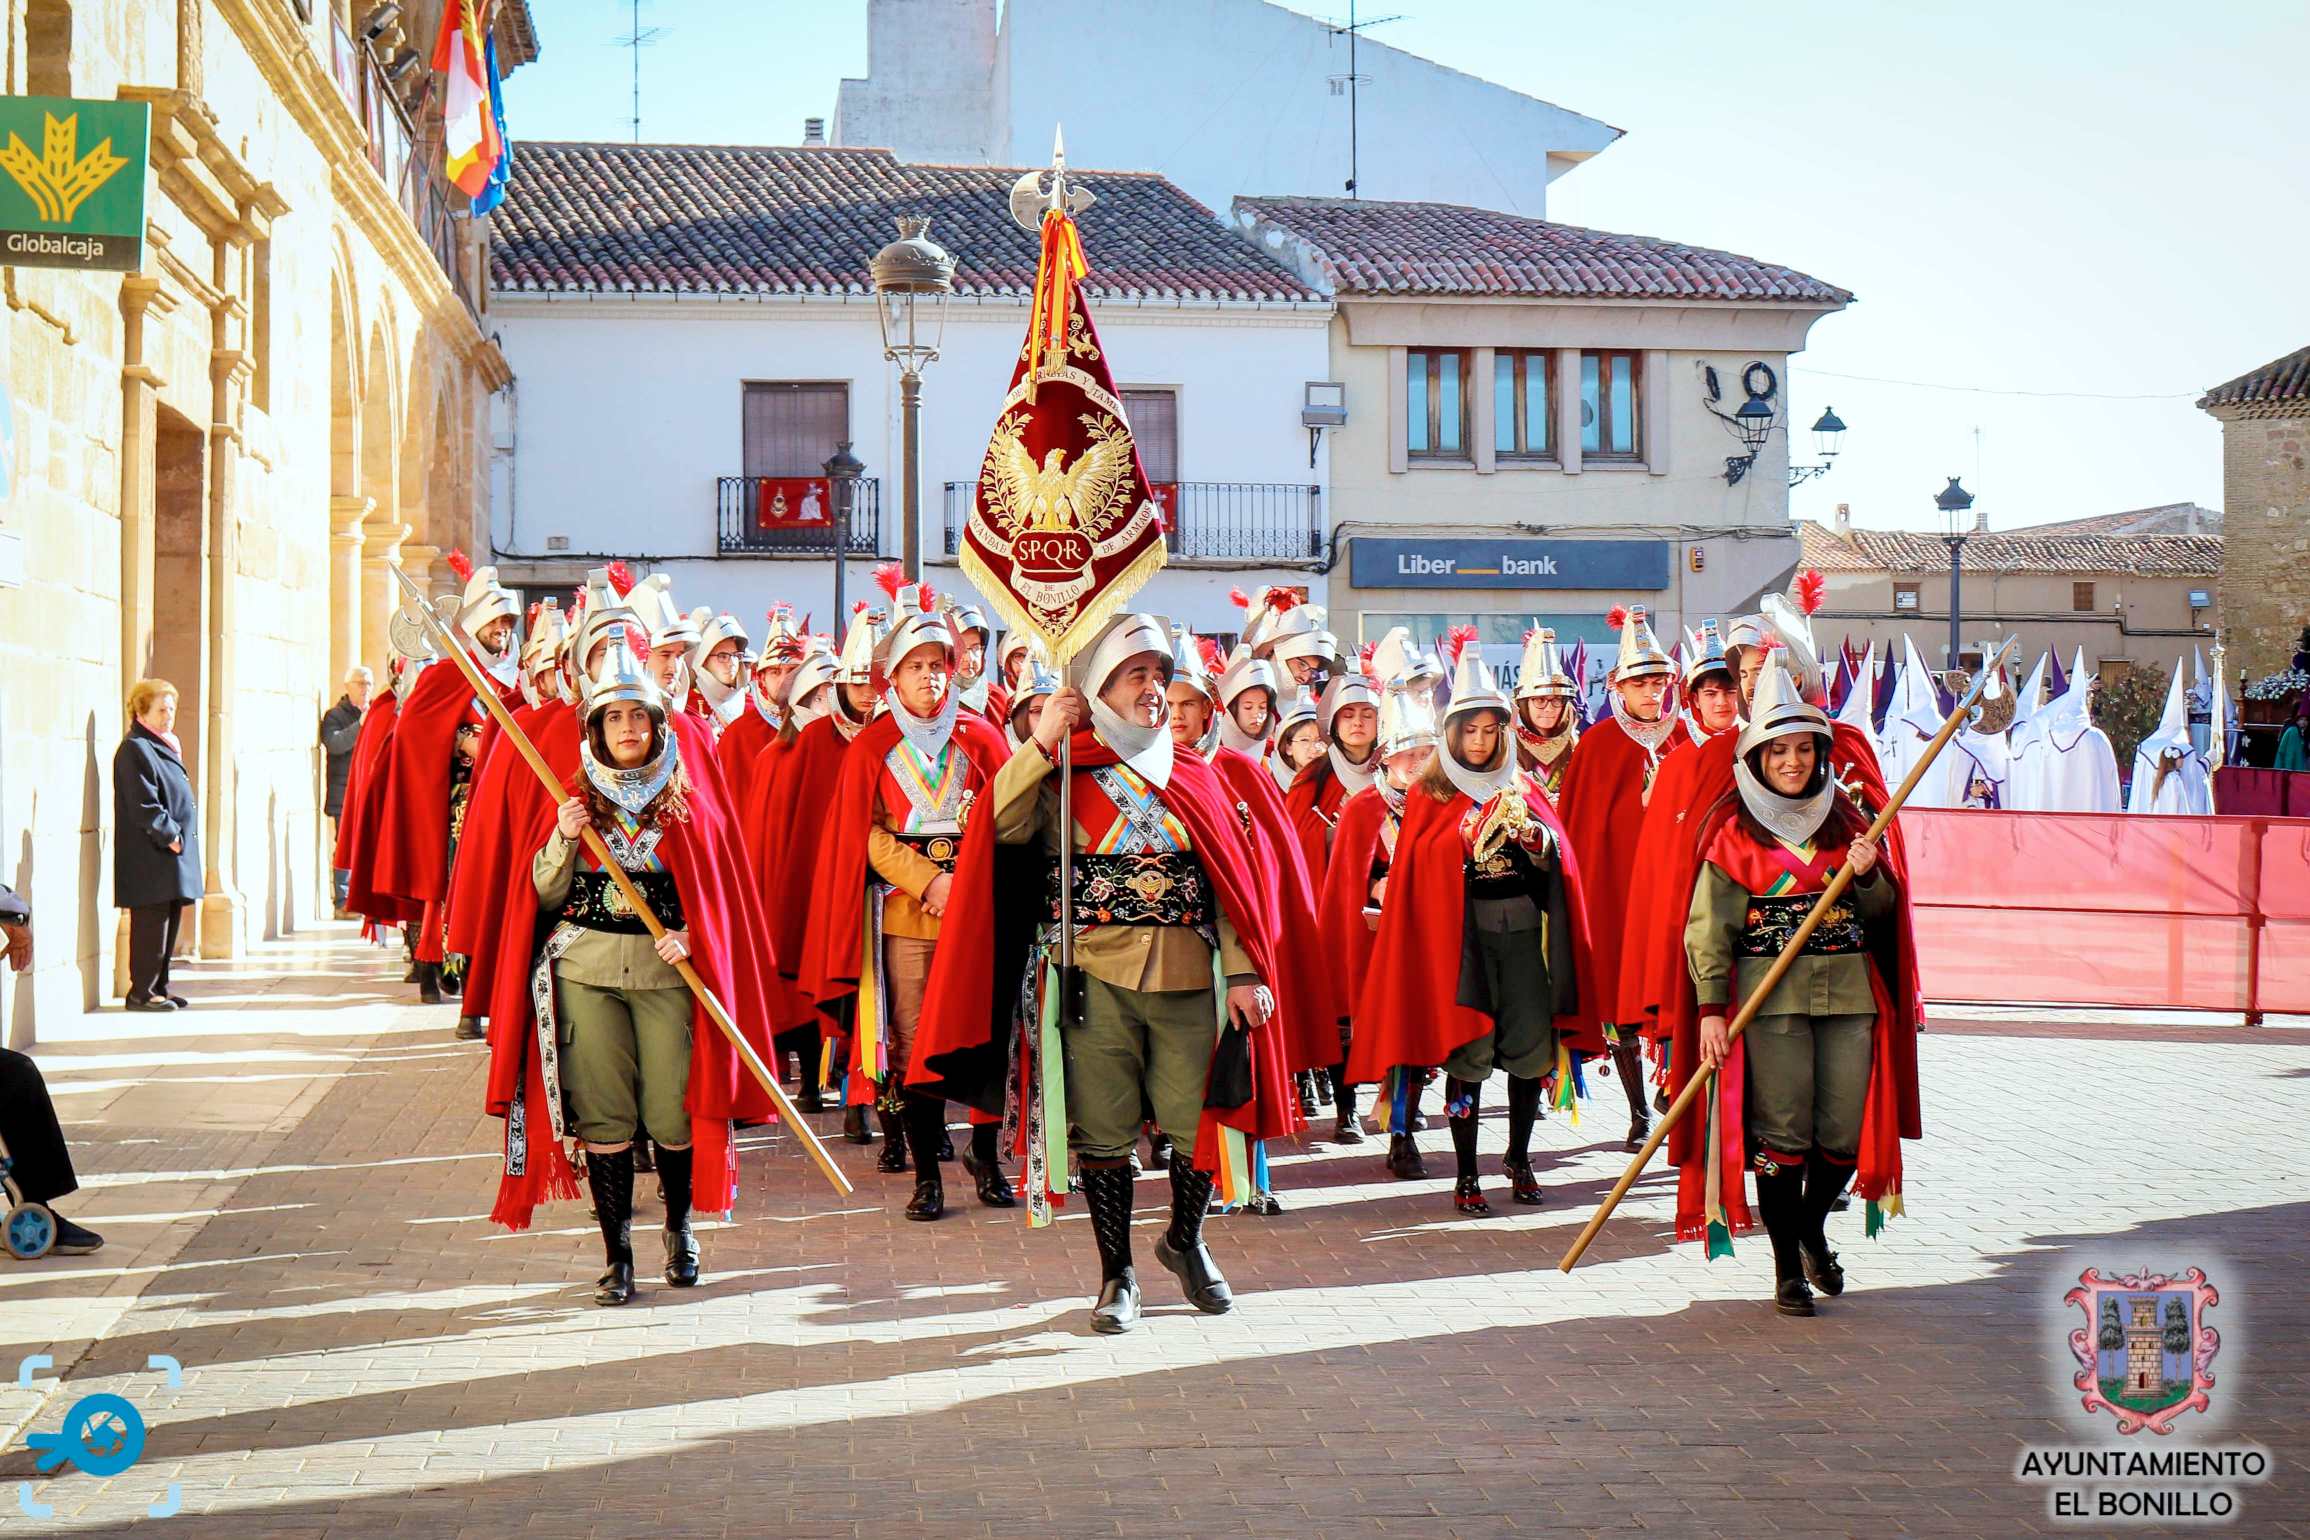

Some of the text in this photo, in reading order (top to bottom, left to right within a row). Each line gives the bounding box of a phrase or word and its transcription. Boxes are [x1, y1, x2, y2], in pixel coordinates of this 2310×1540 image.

[7, 234, 104, 260] Globalcaja
[1398, 554, 1558, 576] Liber bank
[1036, 584, 1080, 604] BONILLO
